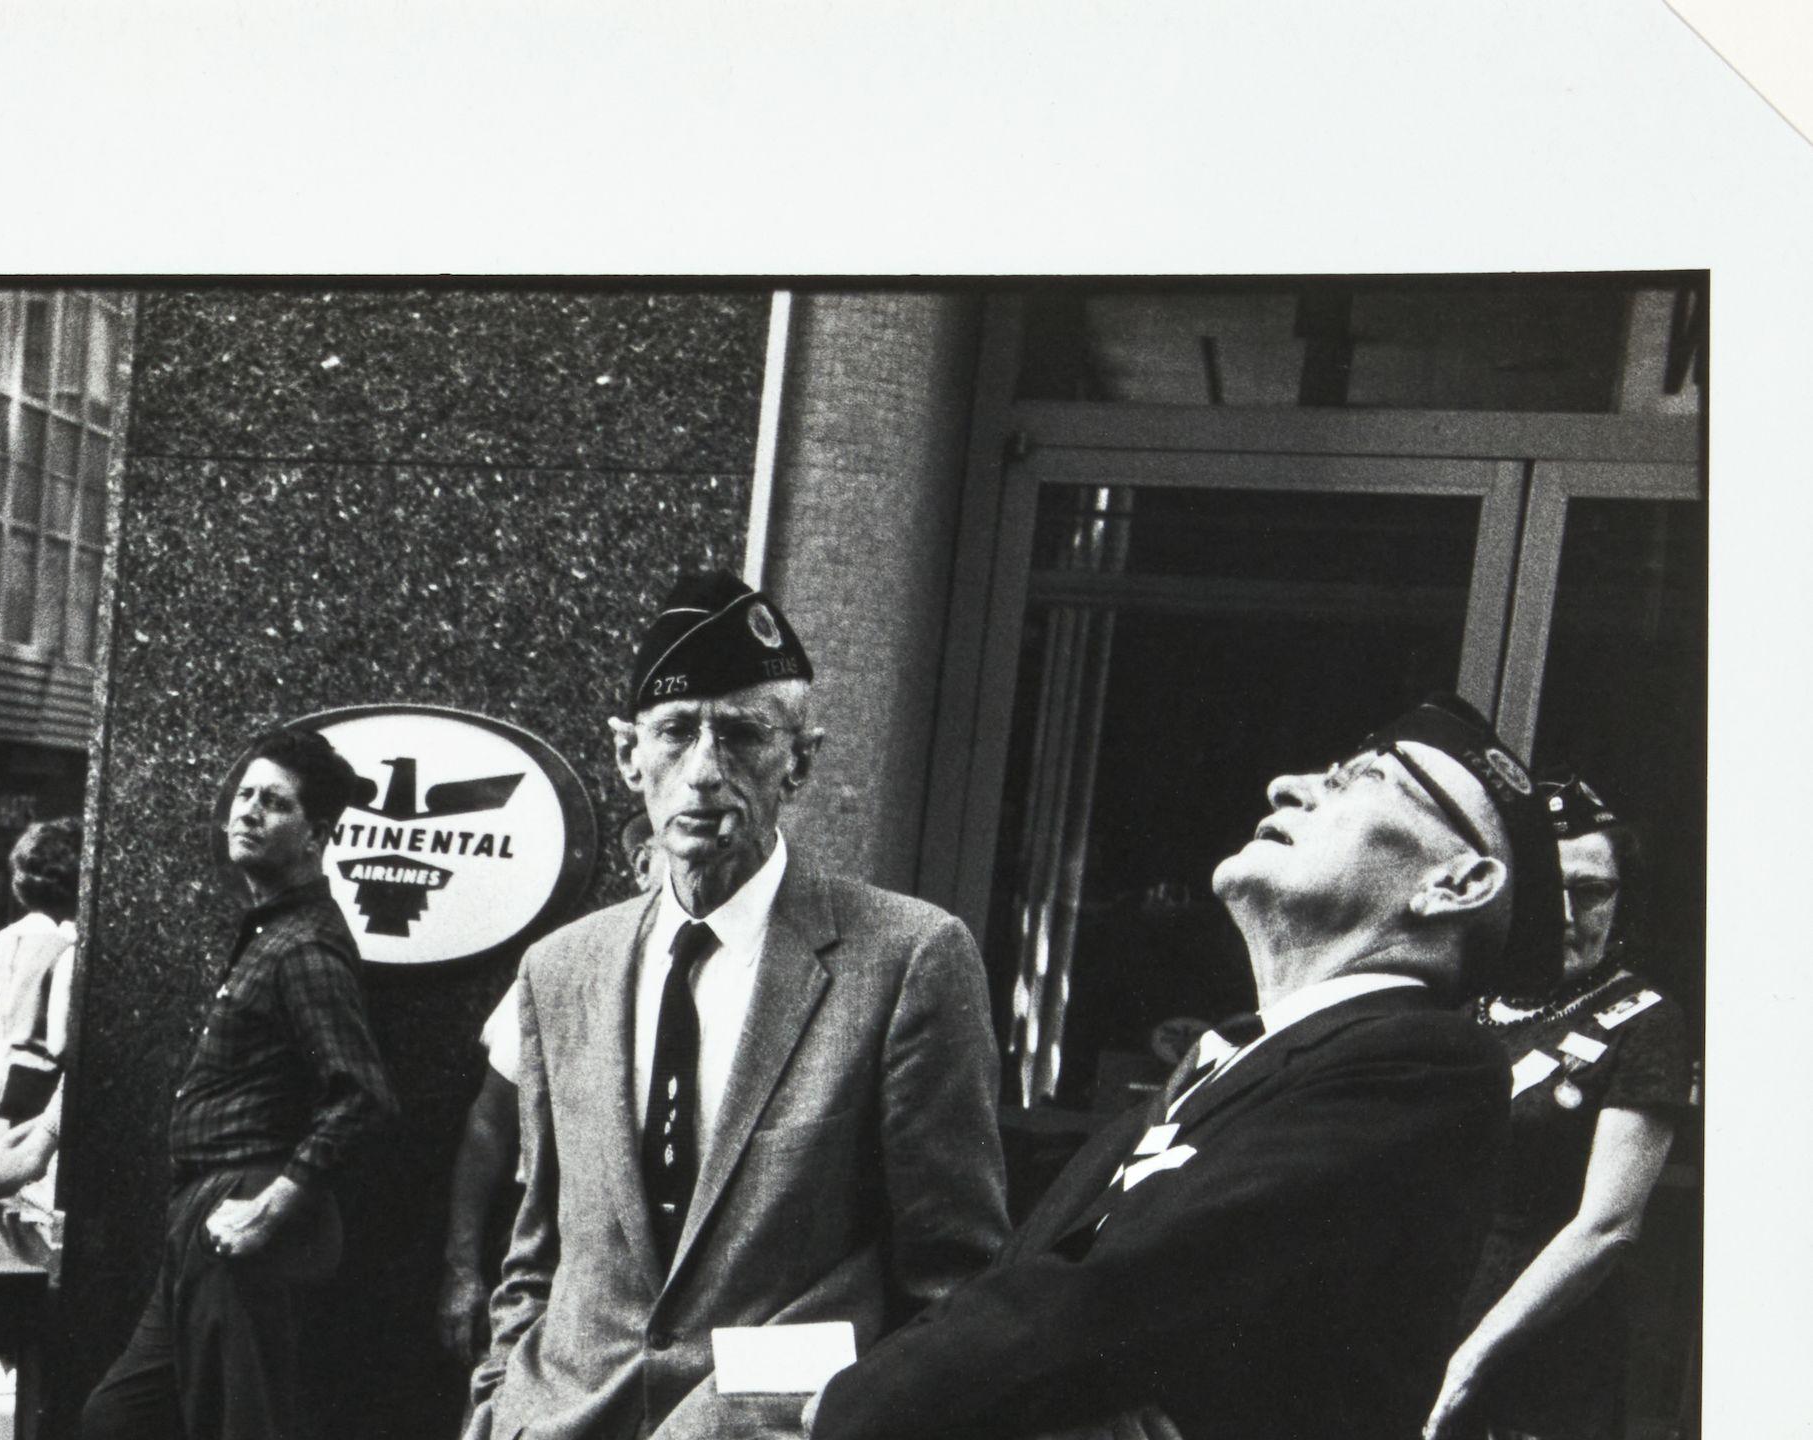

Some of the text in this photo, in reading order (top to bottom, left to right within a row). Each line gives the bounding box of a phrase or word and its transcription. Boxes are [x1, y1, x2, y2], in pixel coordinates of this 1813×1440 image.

[653, 675, 688, 696] 275
[329, 823, 514, 859] NTINENTAL
[349, 863, 441, 886] AIRLINES
